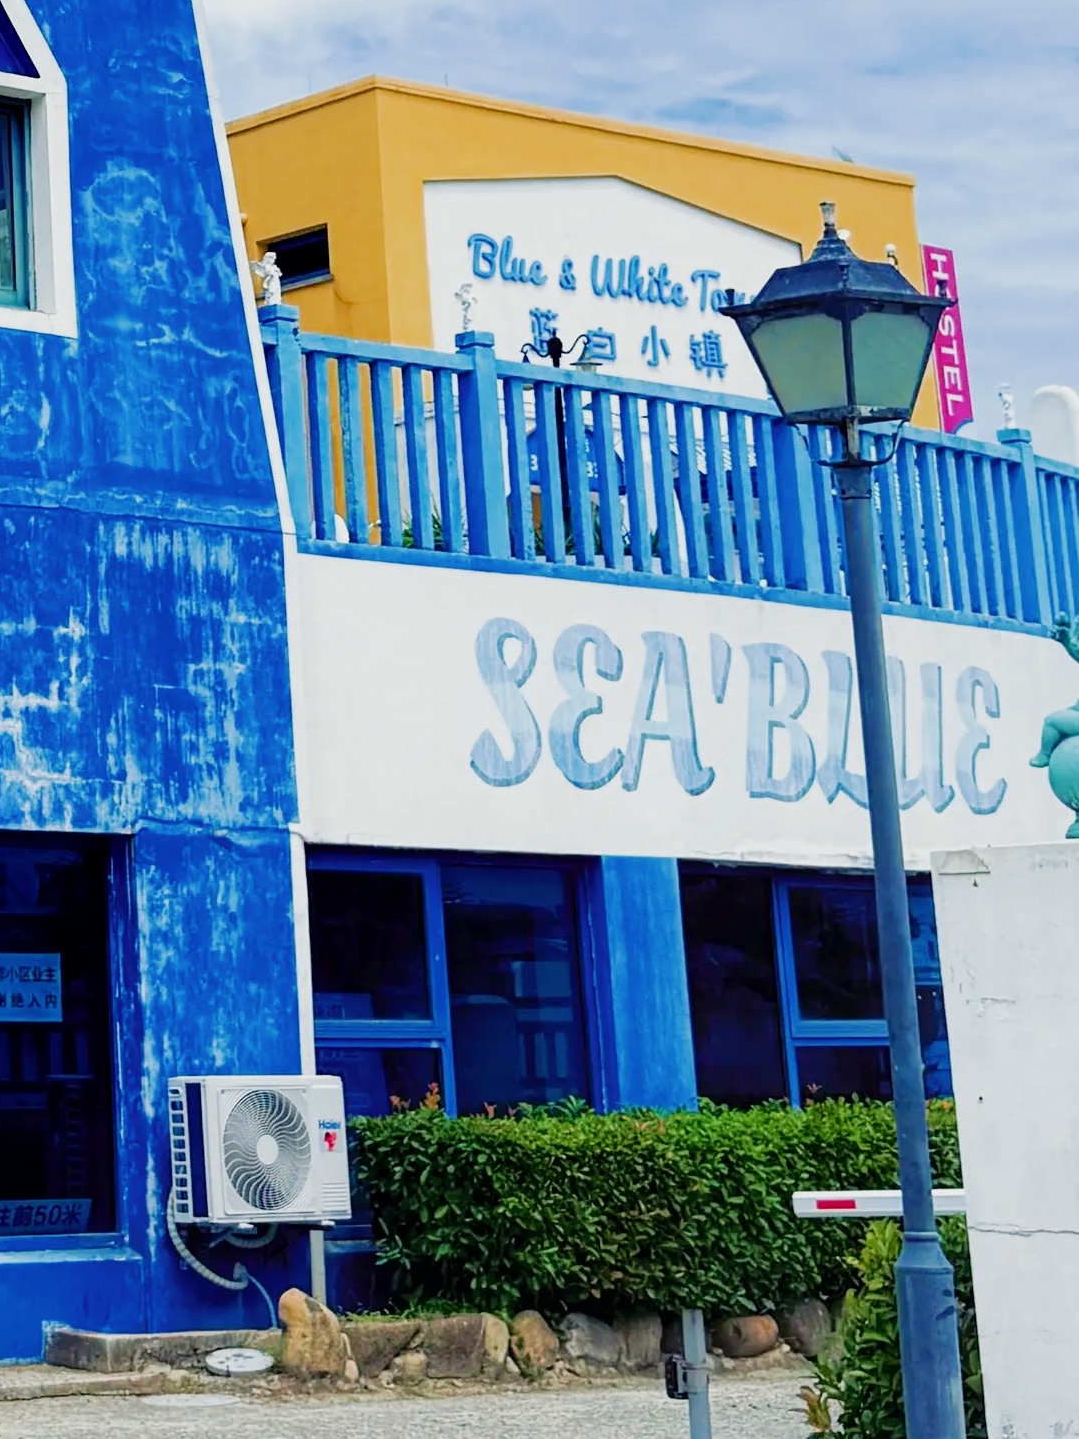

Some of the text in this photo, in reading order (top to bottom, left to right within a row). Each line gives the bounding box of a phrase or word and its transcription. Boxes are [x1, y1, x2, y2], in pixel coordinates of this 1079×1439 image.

[467, 233, 547, 286] Blue
[559, 258, 577, 292] &
[590, 254, 689, 308] White
